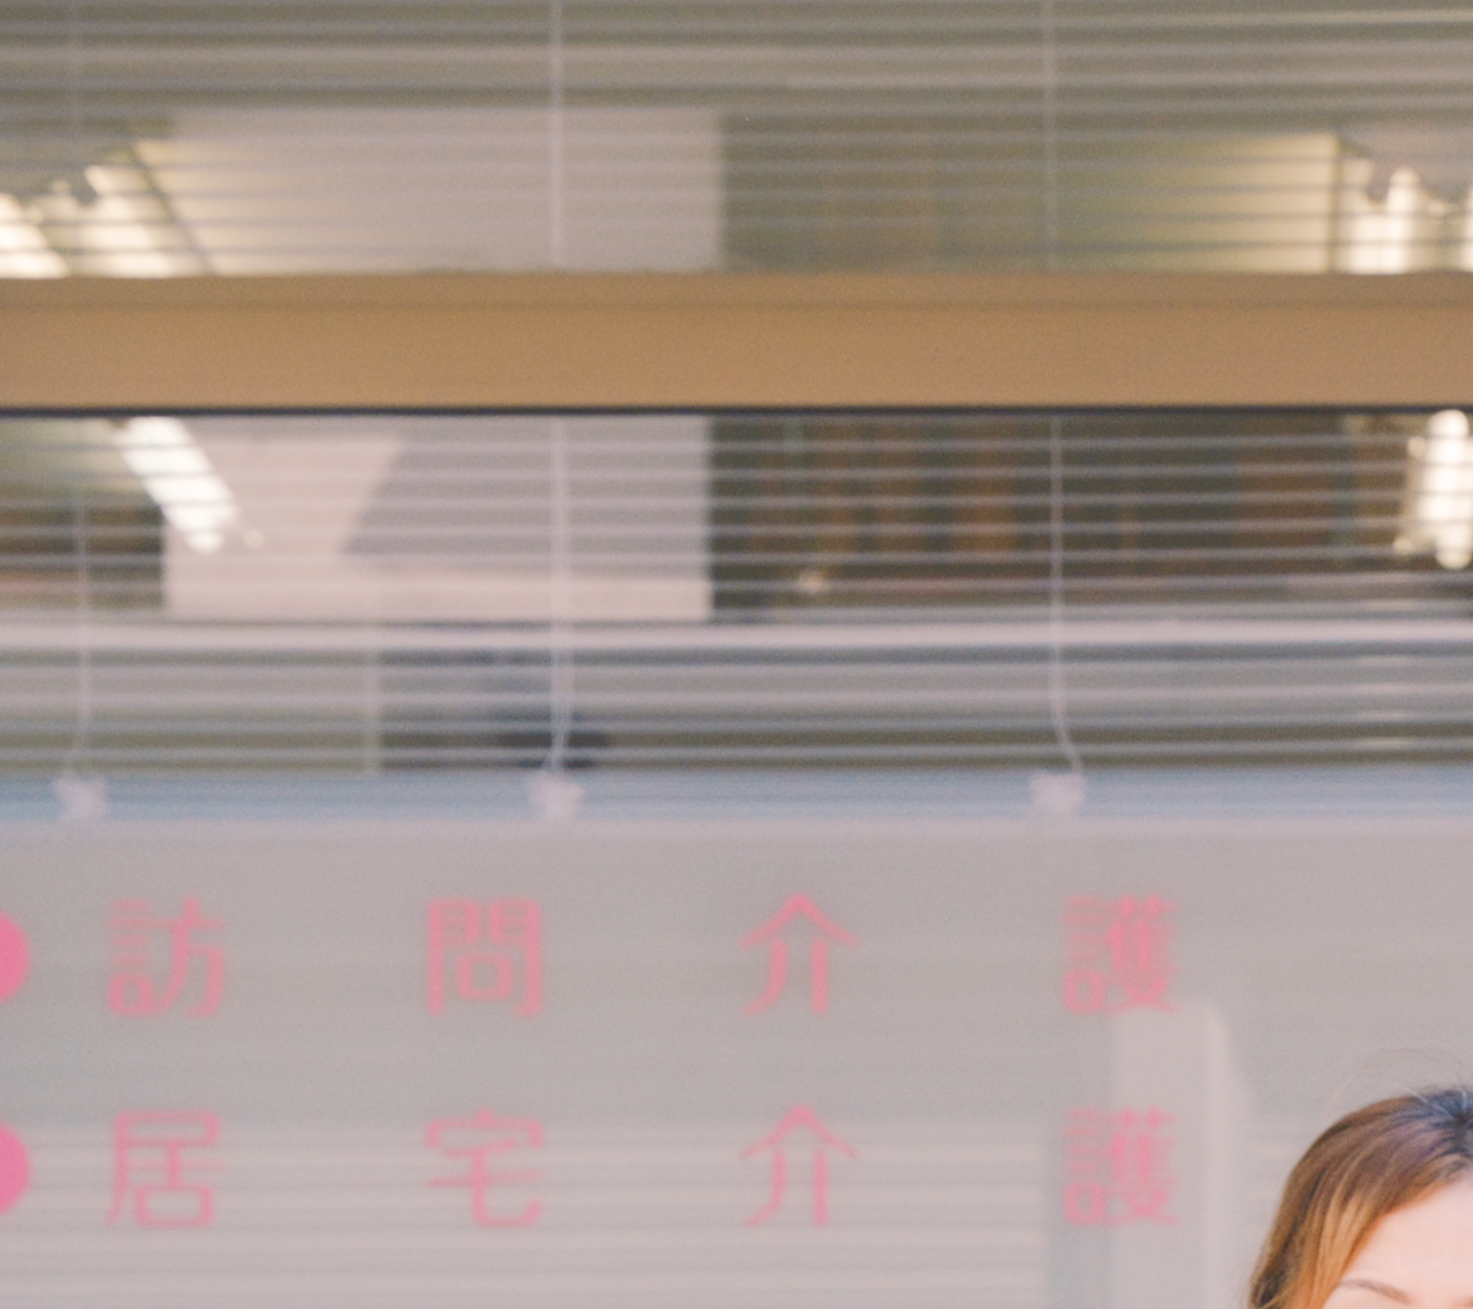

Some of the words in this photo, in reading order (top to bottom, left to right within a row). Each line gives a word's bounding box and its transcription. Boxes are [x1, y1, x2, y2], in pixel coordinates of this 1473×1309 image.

[105, 890, 1180, 1019] 訪問介護
[106, 1102, 1180, 1230] 居宅介護
